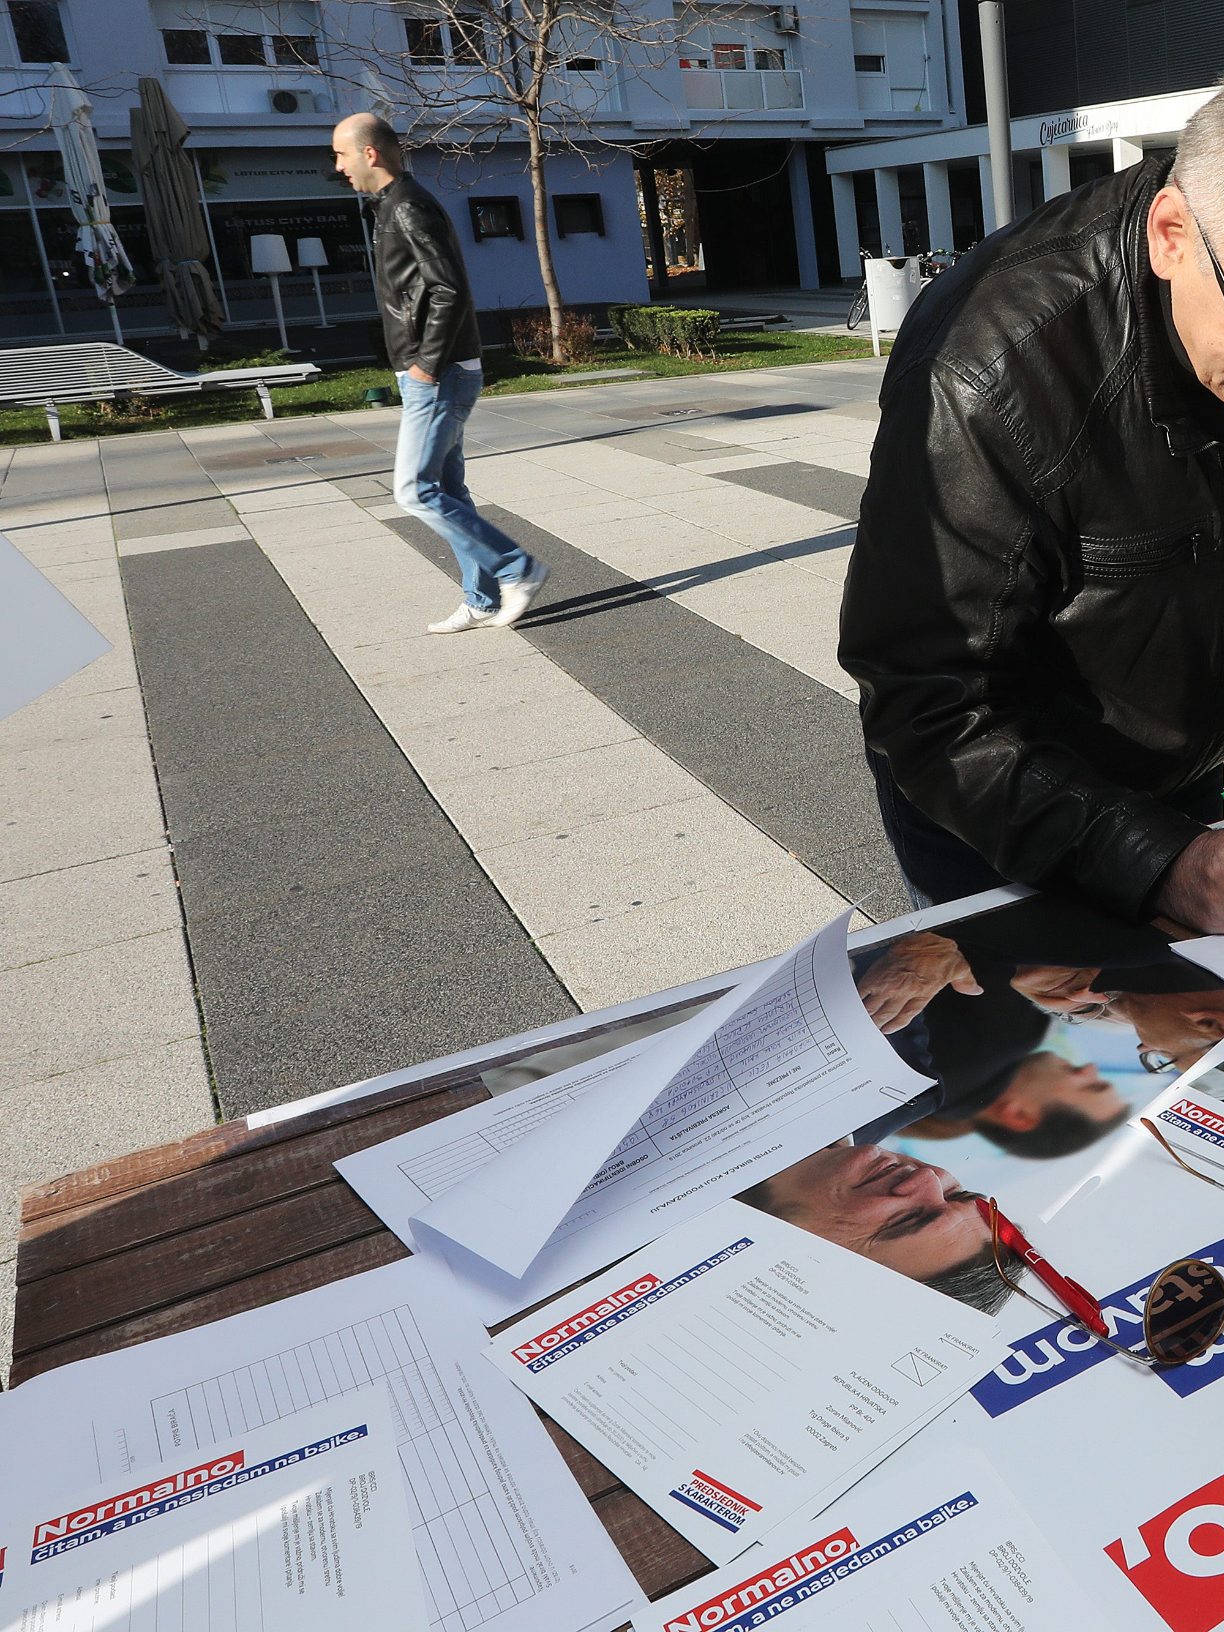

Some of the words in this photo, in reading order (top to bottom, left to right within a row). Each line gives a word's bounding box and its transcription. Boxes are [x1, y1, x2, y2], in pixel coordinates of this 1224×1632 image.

[225, 217, 275, 227] LOTUS
[279, 216, 313, 225] CITY
[317, 214, 348, 223] BAR
[668, 1117, 705, 1141] PREBIVALIŠTA
[705, 1104, 730, 1122] ADRESA
[1159, 1109, 1193, 1131] čitam,
[1192, 1126, 1201, 1135] a
[1203, 1131, 1218, 1143] ne
[722, 1157, 752, 1177] BIRAČA
[753, 1142, 782, 1161] POTPISI
[703, 1173, 722, 1186] KOJI
[649, 1182, 703, 1214] PODRŽAVAJU
[515, 1271, 661, 1363] Normalno,
[531, 1335, 584, 1372] čitam,
[584, 1330, 595, 1342] a
[595, 1318, 616, 1335] ne
[617, 1276, 685, 1321] nasjedam
[686, 1265, 706, 1281] na
[704, 1237, 751, 1269] bajke.
[825, 1404, 842, 1417] Zoran
[831, 1375, 862, 1396] REPUBLIKA
[858, 1394, 888, 1415] HRVATSKA
[168, 1408, 177, 1428] BIRAČA
[172, 1428, 181, 1446] POTPIS
[30, 1452, 245, 1545] Normalno,
[32, 1523, 107, 1561] čitam,
[111, 1519, 126, 1532] a
[130, 1506, 159, 1525] ne
[162, 1464, 263, 1512] nasjedam
[273, 1453, 300, 1470] na
[301, 1426, 365, 1459] bajke.
[678, 1482, 687, 1492] S
[684, 1486, 745, 1526] KARAKTEROM
[689, 1477, 749, 1517] PREDSJEDNIK
[750, 1610, 766, 1625] a
[766, 1594, 795, 1617] ne
[794, 1538, 892, 1600] nasjedam
[892, 1525, 919, 1547] na
[917, 1492, 975, 1533] bajke.
[996, 1544, 1011, 1560] BROJ
[1007, 1558, 1032, 1585] DOZVOLE
[666, 1538, 860, 1632] Normalno,
